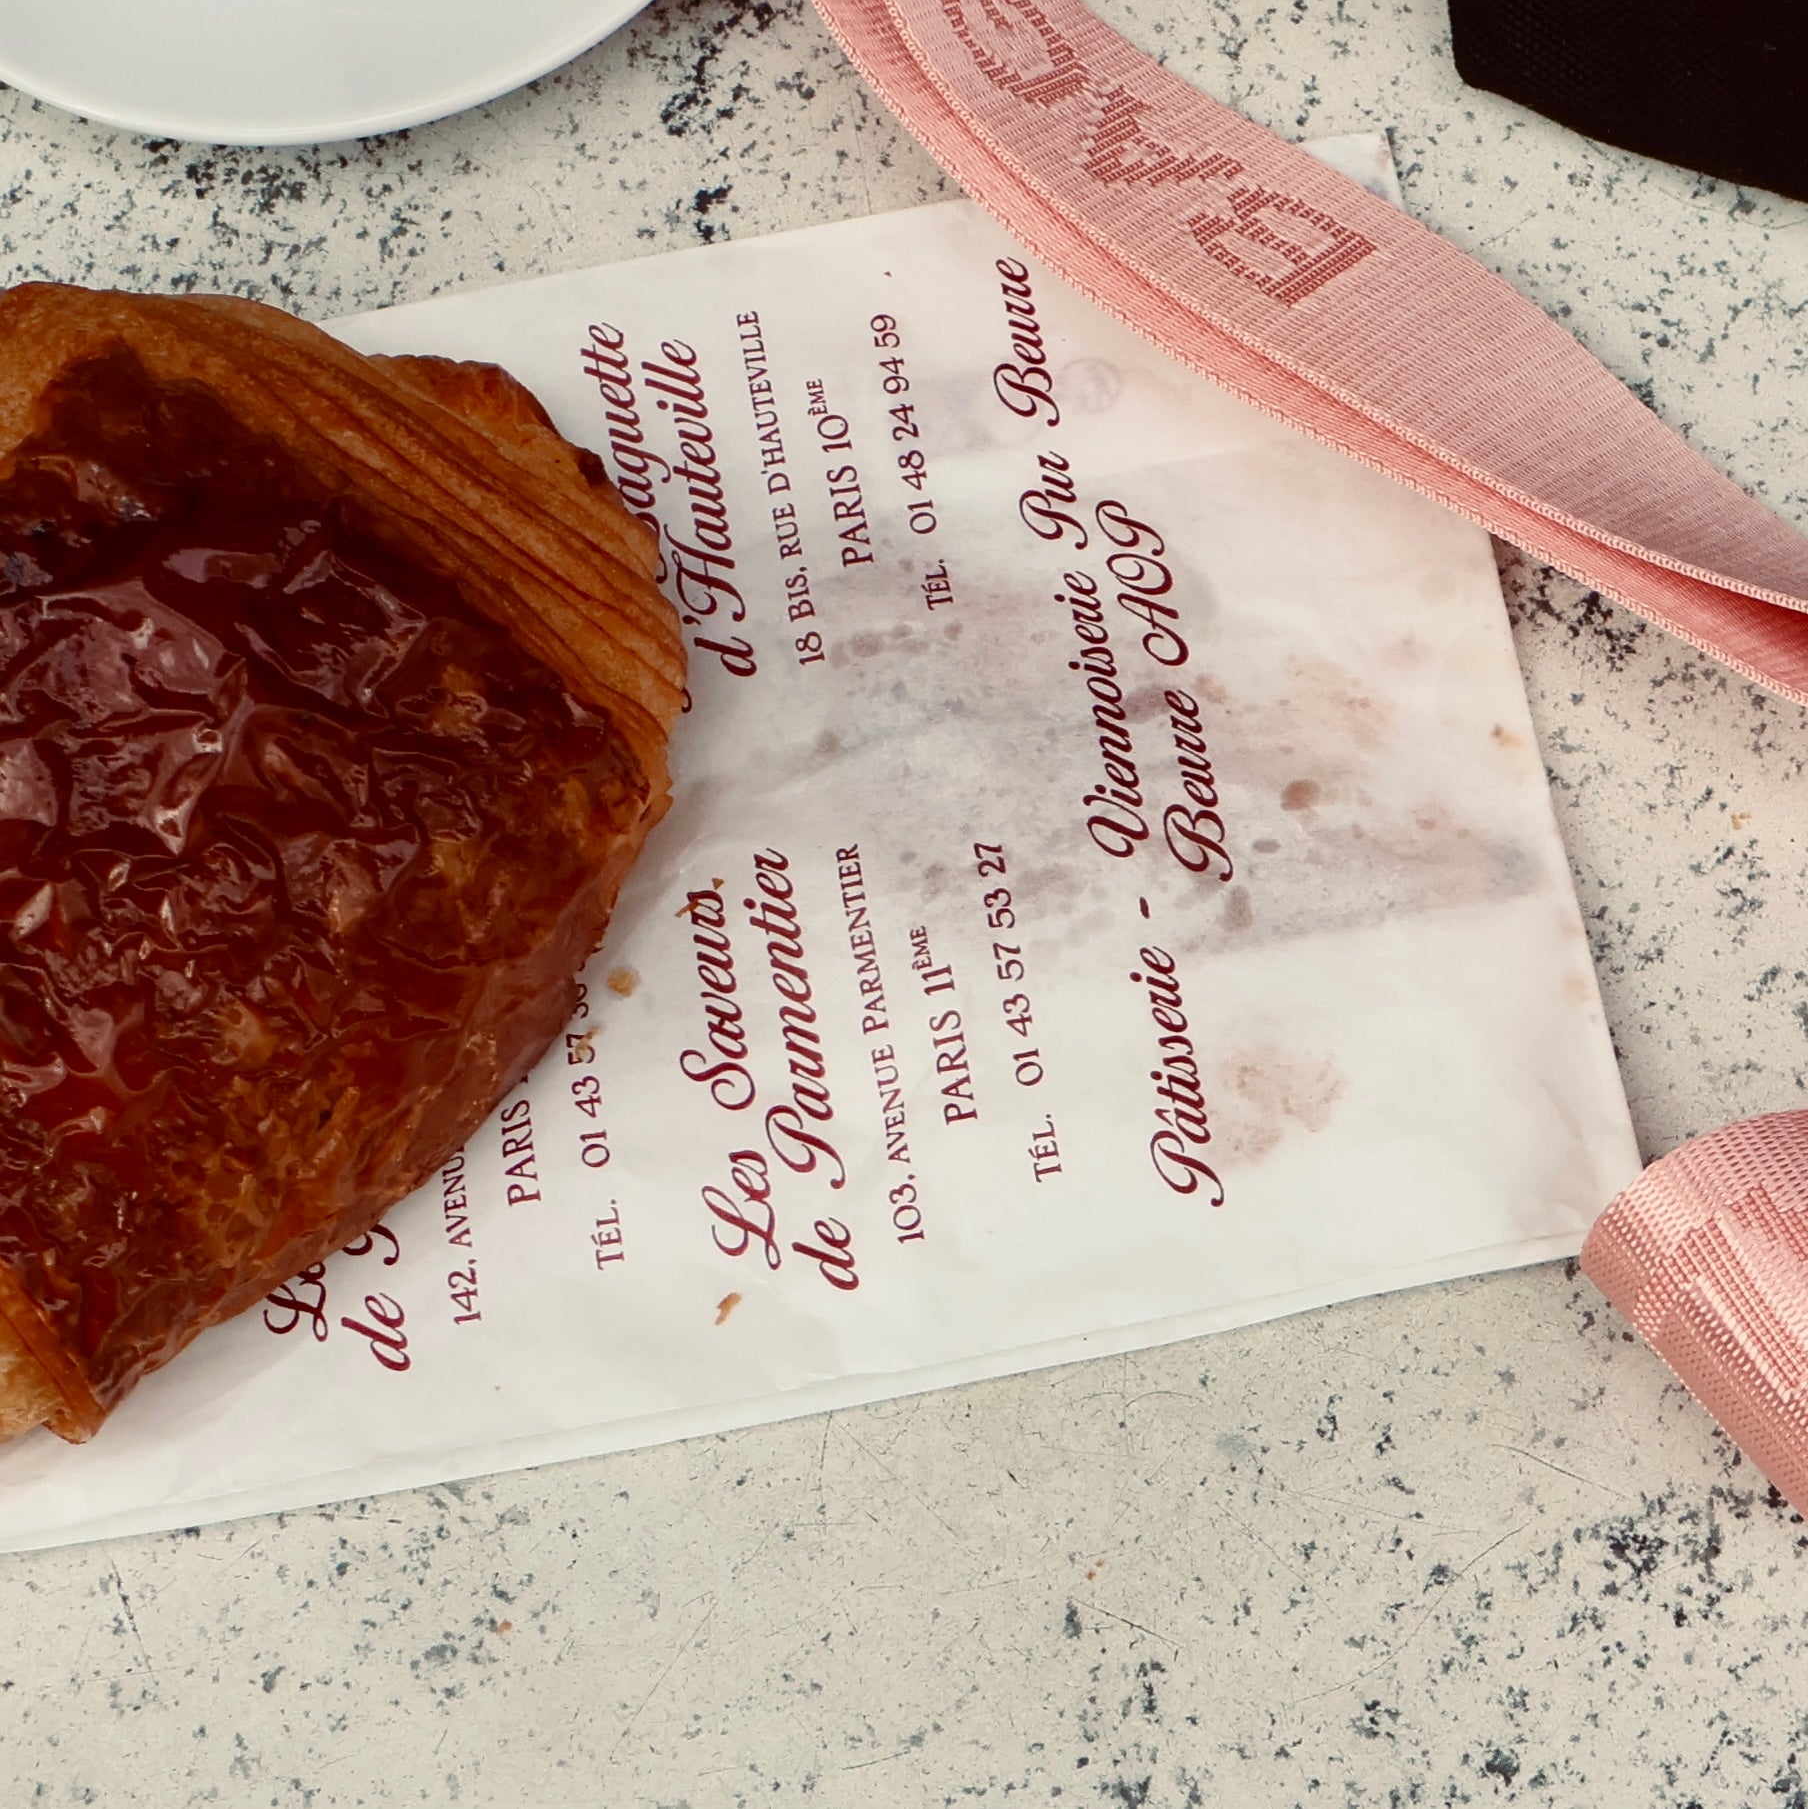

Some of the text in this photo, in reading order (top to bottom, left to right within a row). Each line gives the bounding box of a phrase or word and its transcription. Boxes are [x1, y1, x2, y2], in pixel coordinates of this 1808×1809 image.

[735, 310, 791, 495] D'HAUTEVILLE
[993, 256, 1060, 427] Beurre
[640, 338, 757, 677] d'Hauteville
[773, 502, 803, 560] RUE
[826, 465, 875, 568] PARIS
[870, 314, 954, 611] TÉL. 01 48 24 94 59
[1019, 451, 1089, 551] Pur
[794, 631, 826, 666] 18
[1053, 571, 1151, 858] Viennoiserie
[1094, 499, 1234, 883] Beurre AOP
[680, 890, 782, 1271] Les Saveurs
[743, 847, 860, 1291] de Parmentier
[835, 844, 925, 1244] 103, AVENUE PARMENTIER
[929, 1010, 978, 1125] PARIS
[973, 842, 1062, 1182] TÉL. 01 43 57 53 27
[1129, 947, 1225, 1208] Pâtisserie
[500, 1099, 542, 1207] PARIS
[571, 1076, 602, 1118] 43
[580, 1131, 613, 1168] 01
[448, 1257, 482, 1326] 142,
[592, 1198, 625, 1269] TÉL.
[341, 1292, 411, 1372] de
